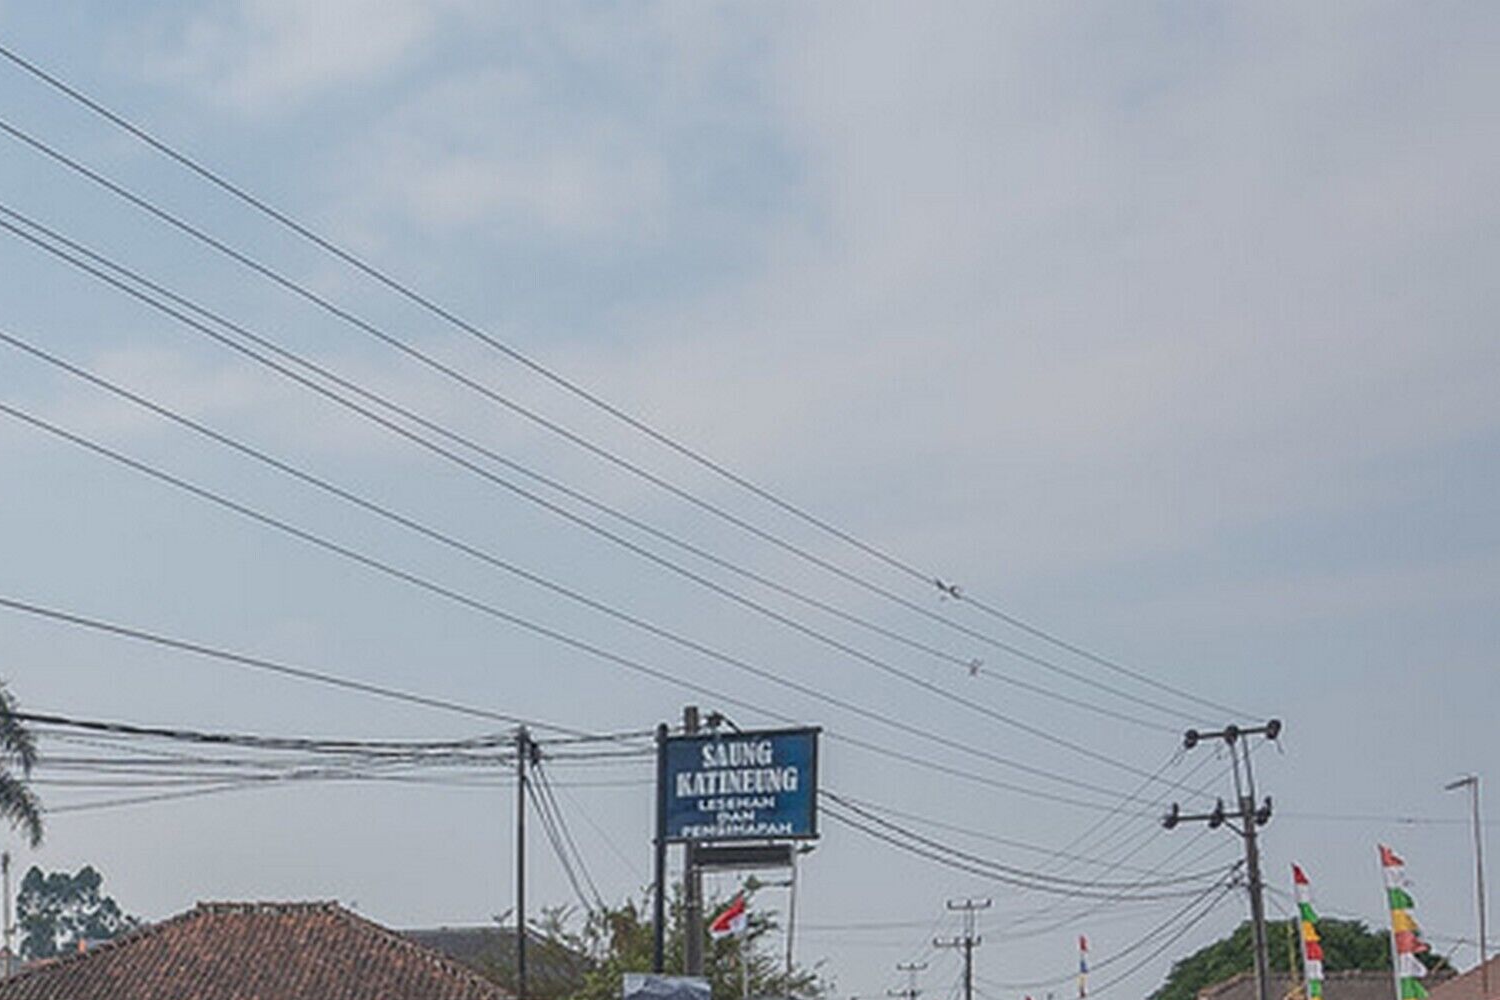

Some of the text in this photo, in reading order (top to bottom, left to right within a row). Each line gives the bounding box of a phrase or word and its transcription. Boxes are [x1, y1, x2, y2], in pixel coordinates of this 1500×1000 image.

[702, 740, 773, 768] SAUNG
[676, 766, 799, 798] KATINEUNG
[698, 796, 776, 811] LESEHAN
